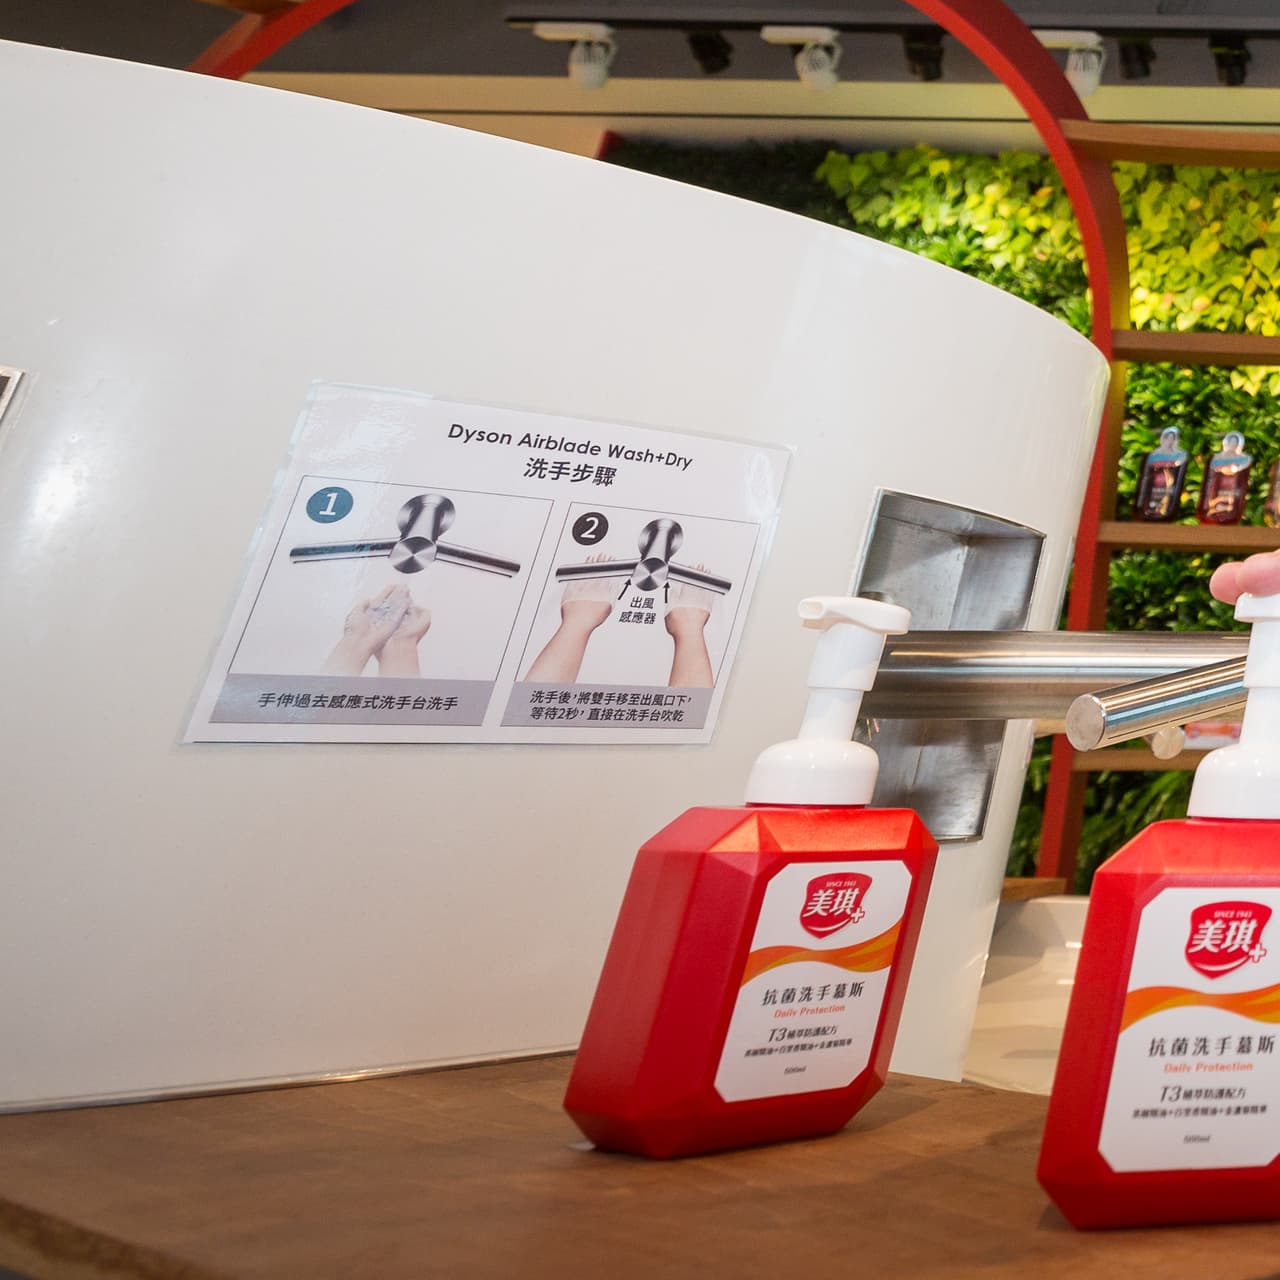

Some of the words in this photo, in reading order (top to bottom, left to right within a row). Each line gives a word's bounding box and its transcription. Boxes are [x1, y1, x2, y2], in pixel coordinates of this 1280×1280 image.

[447, 423, 513, 445] Dyson
[518, 432, 601, 456] Airblade
[608, 443, 693, 471] Wash+Dry
[523, 456, 618, 487] 洗手步驟
[319, 492, 338, 516] 1
[580, 516, 600, 539] 2
[630, 596, 655, 610] 出風
[802, 887, 860, 918] 美琪
[1187, 918, 1258, 953] 美琪
[762, 981, 866, 1007] 抗菌洗手慕斯
[1149, 1034, 1276, 1057] 抗菌洗手慕斯
